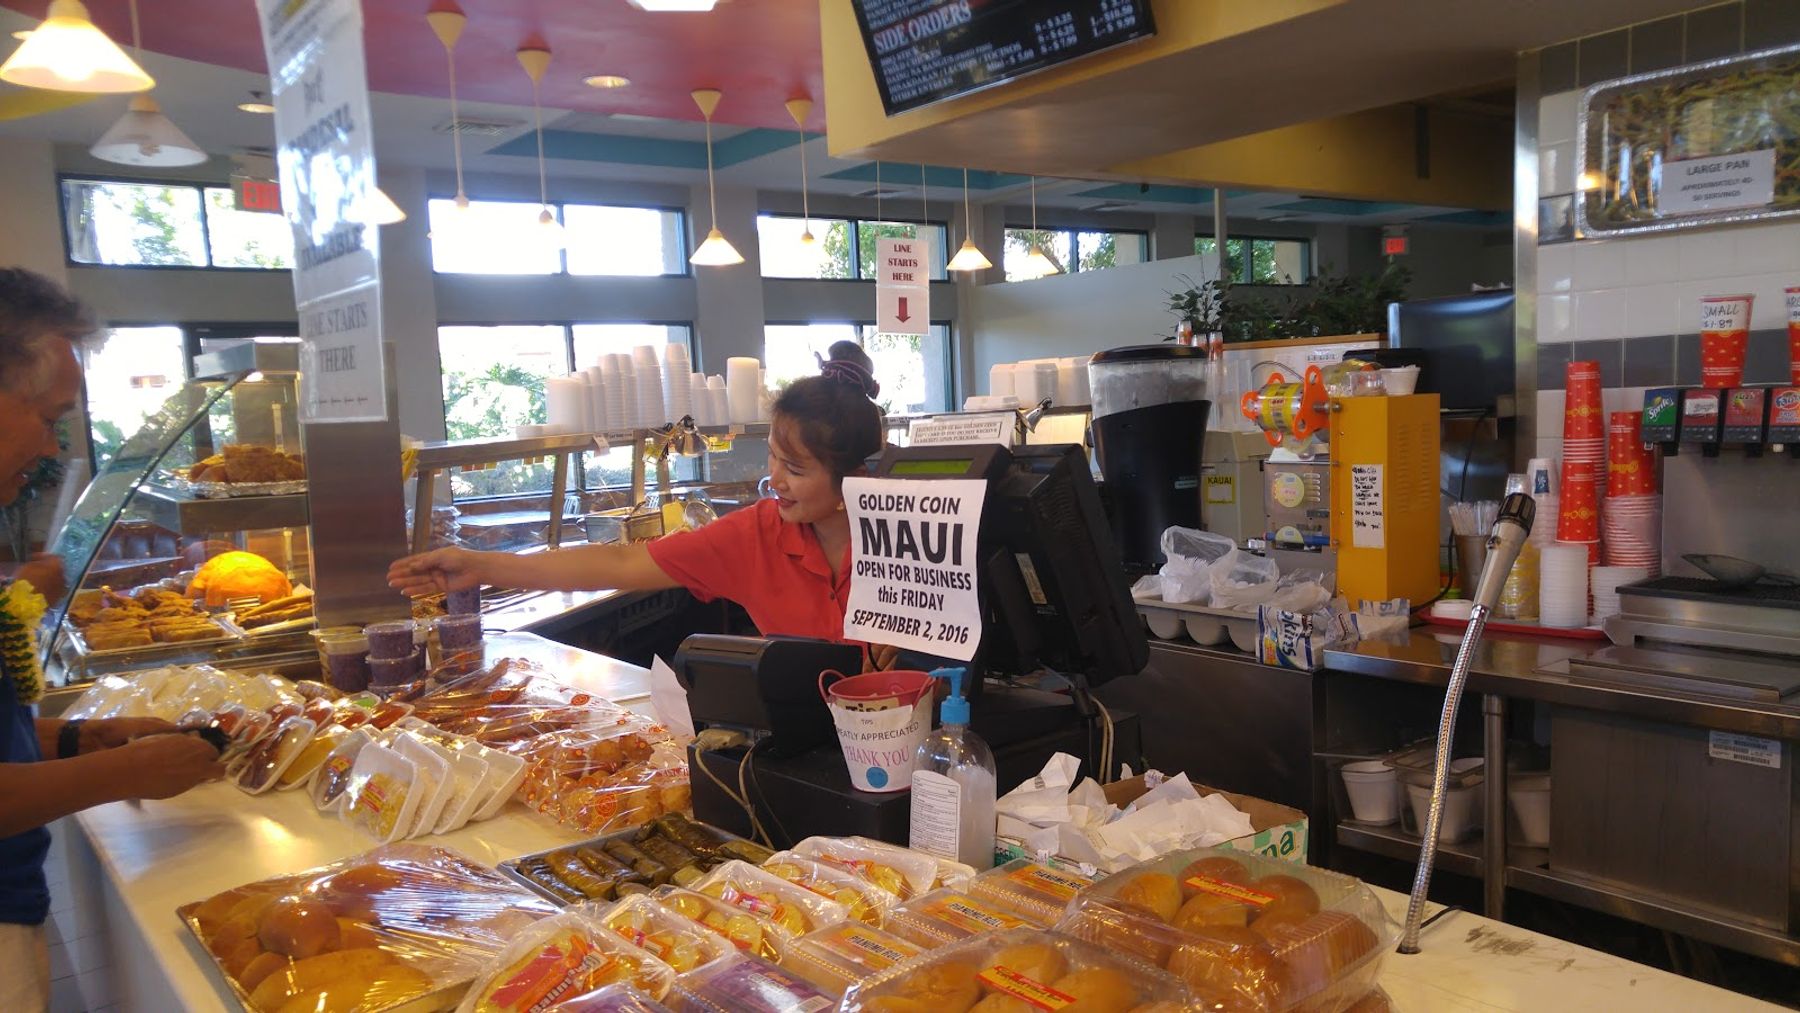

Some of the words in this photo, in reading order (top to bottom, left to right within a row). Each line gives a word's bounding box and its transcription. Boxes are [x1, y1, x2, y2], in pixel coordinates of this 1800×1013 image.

[873, 23, 909, 55] SIDE
[908, 0, 972, 41] ORDERS
[1686, 162, 1722, 176] LARGE
[1725, 159, 1751, 170] PAN
[1704, 190, 1741, 200] SERVINGS
[893, 243, 912, 254] LINE
[888, 257, 918, 268] STARTS
[892, 272, 914, 281] HERE
[327, 302, 368, 334] STARTS
[1703, 304, 1739, 319] SMALL
[1648, 398, 1672, 422] Sprite
[1208, 477, 1232, 485] KAUAI
[859, 494, 915, 512] GOLDEN
[919, 496, 961, 515] COIN
[859, 517, 964, 566] MAUI
[857, 560, 886, 579] OPEN
[889, 563, 911, 582] FOR
[914, 567, 972, 591] BUSINESS
[878, 585, 898, 604] this
[901, 589, 945, 611] FRIDAY
[852, 609, 920, 637] SEPTEMBER
[922, 621, 934, 642] 2,
[937, 623, 969, 644] 2016
[861, 721, 919, 741] APPRECIATED
[845, 746, 881, 767] THANK
[882, 745, 910, 767] YOU
